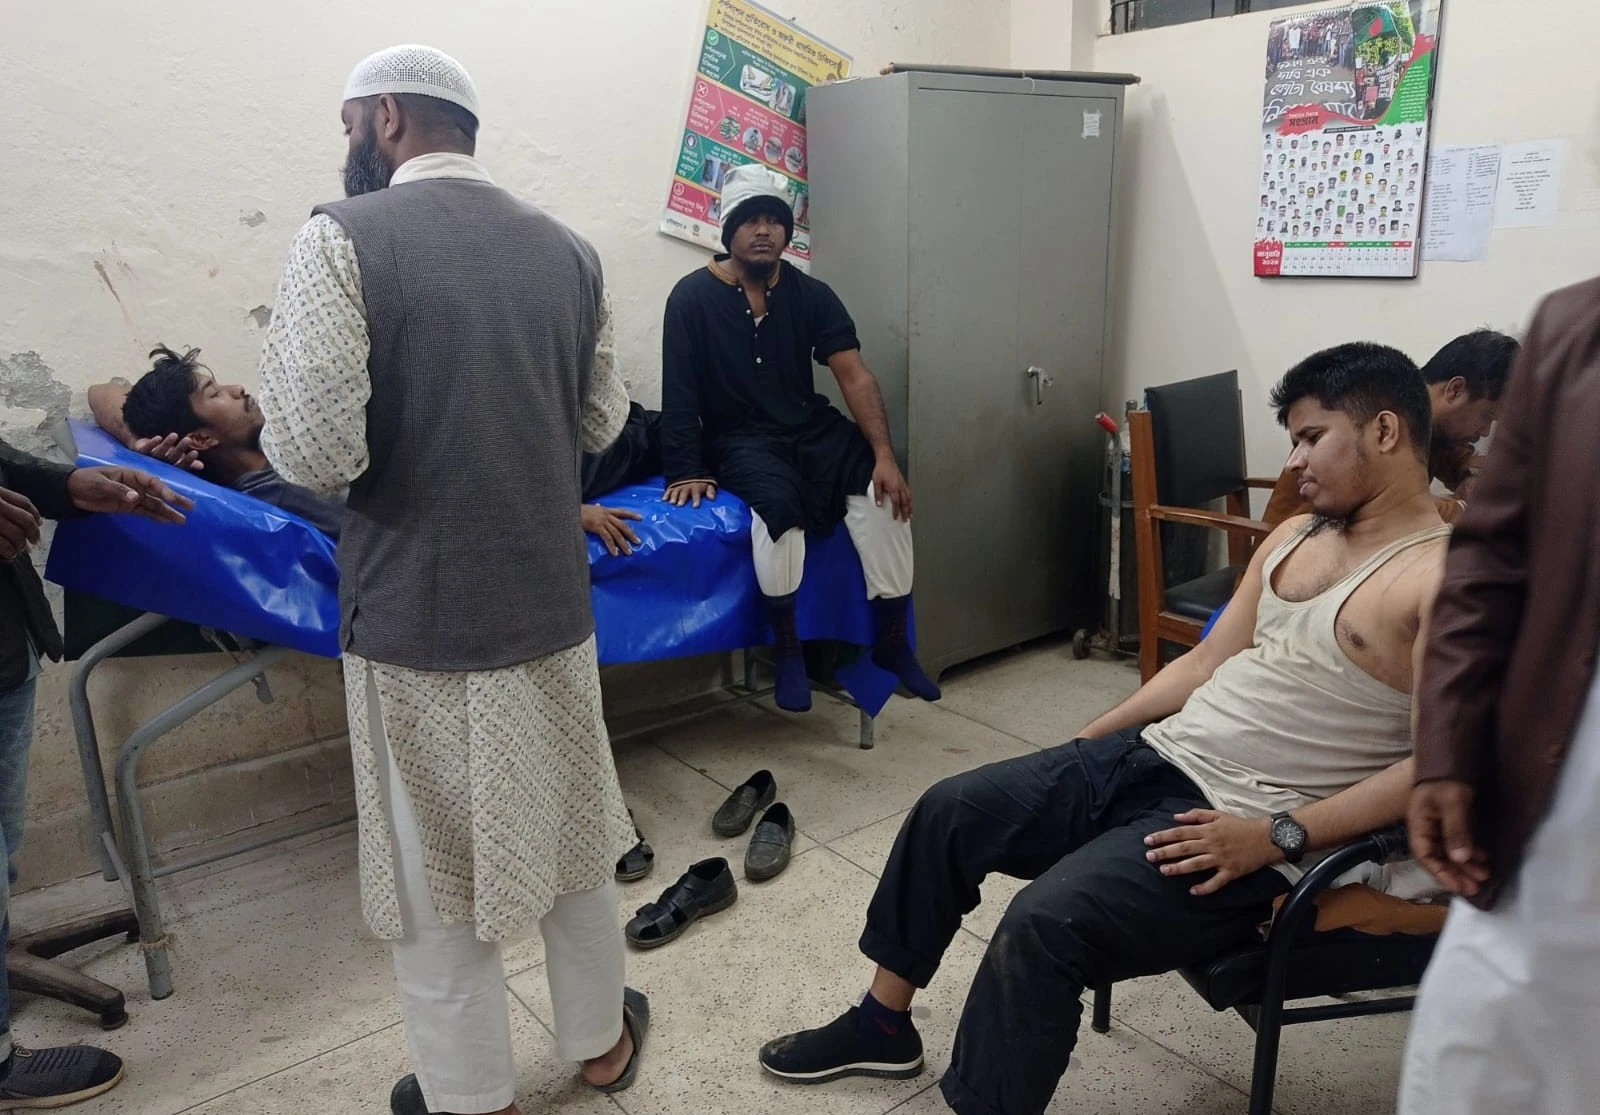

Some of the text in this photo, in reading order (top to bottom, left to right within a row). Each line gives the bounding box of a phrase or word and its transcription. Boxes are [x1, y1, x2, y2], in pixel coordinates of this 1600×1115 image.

[1278, 67, 1332, 80] দাবি এক
[1270, 81, 1305, 96] কোটা
[1306, 80, 1356, 98] বৈষম্য
[1288, 116, 1319, 127] সংগ্রাম
